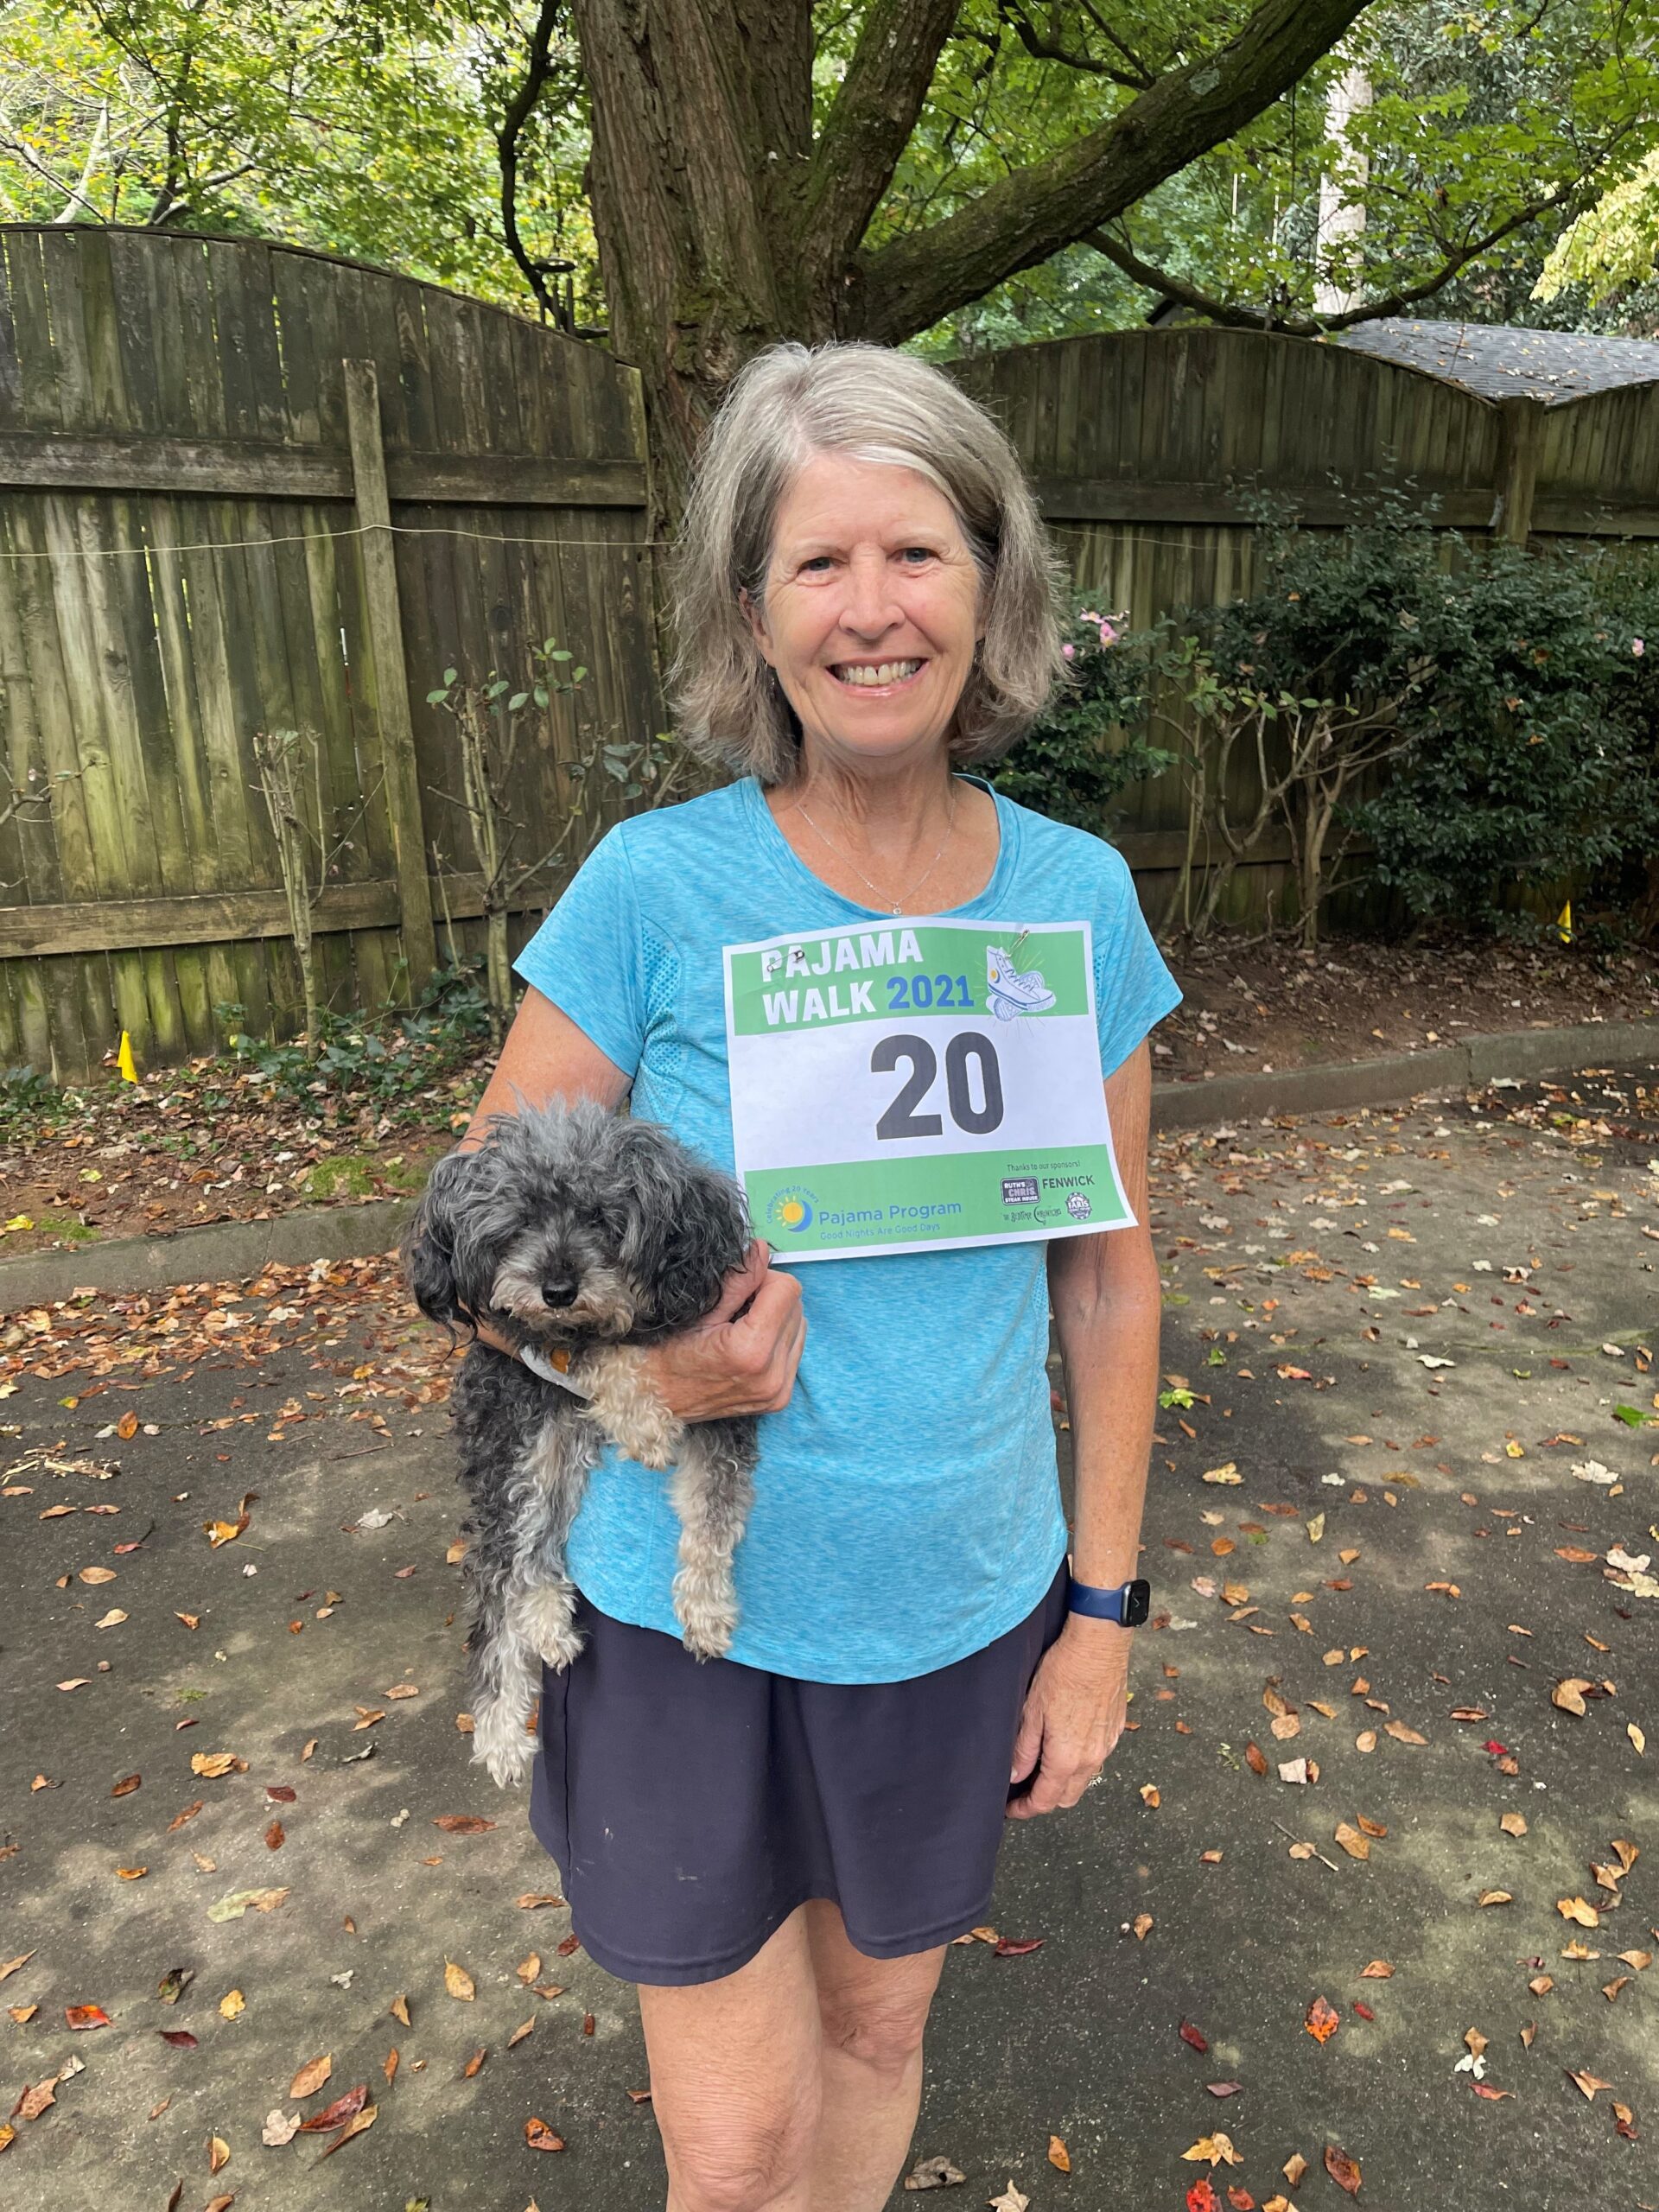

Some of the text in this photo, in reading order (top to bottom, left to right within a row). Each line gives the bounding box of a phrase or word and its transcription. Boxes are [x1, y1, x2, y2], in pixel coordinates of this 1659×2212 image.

[760, 930, 924, 982] PAJAMA
[762, 974, 975, 1026] WALK 2021
[870, 1031, 1004, 1141] 20
[1007, 1163, 1030, 1172] Thanks
[1051, 1160, 1081, 1170] sponsors!
[1008, 1186, 1036, 1198] CHRIS
[1042, 1175, 1095, 1189] FENWICK
[819, 1202, 962, 1225] Pajama Program
[821, 1223, 941, 1240] Good Nights Are Good Days
